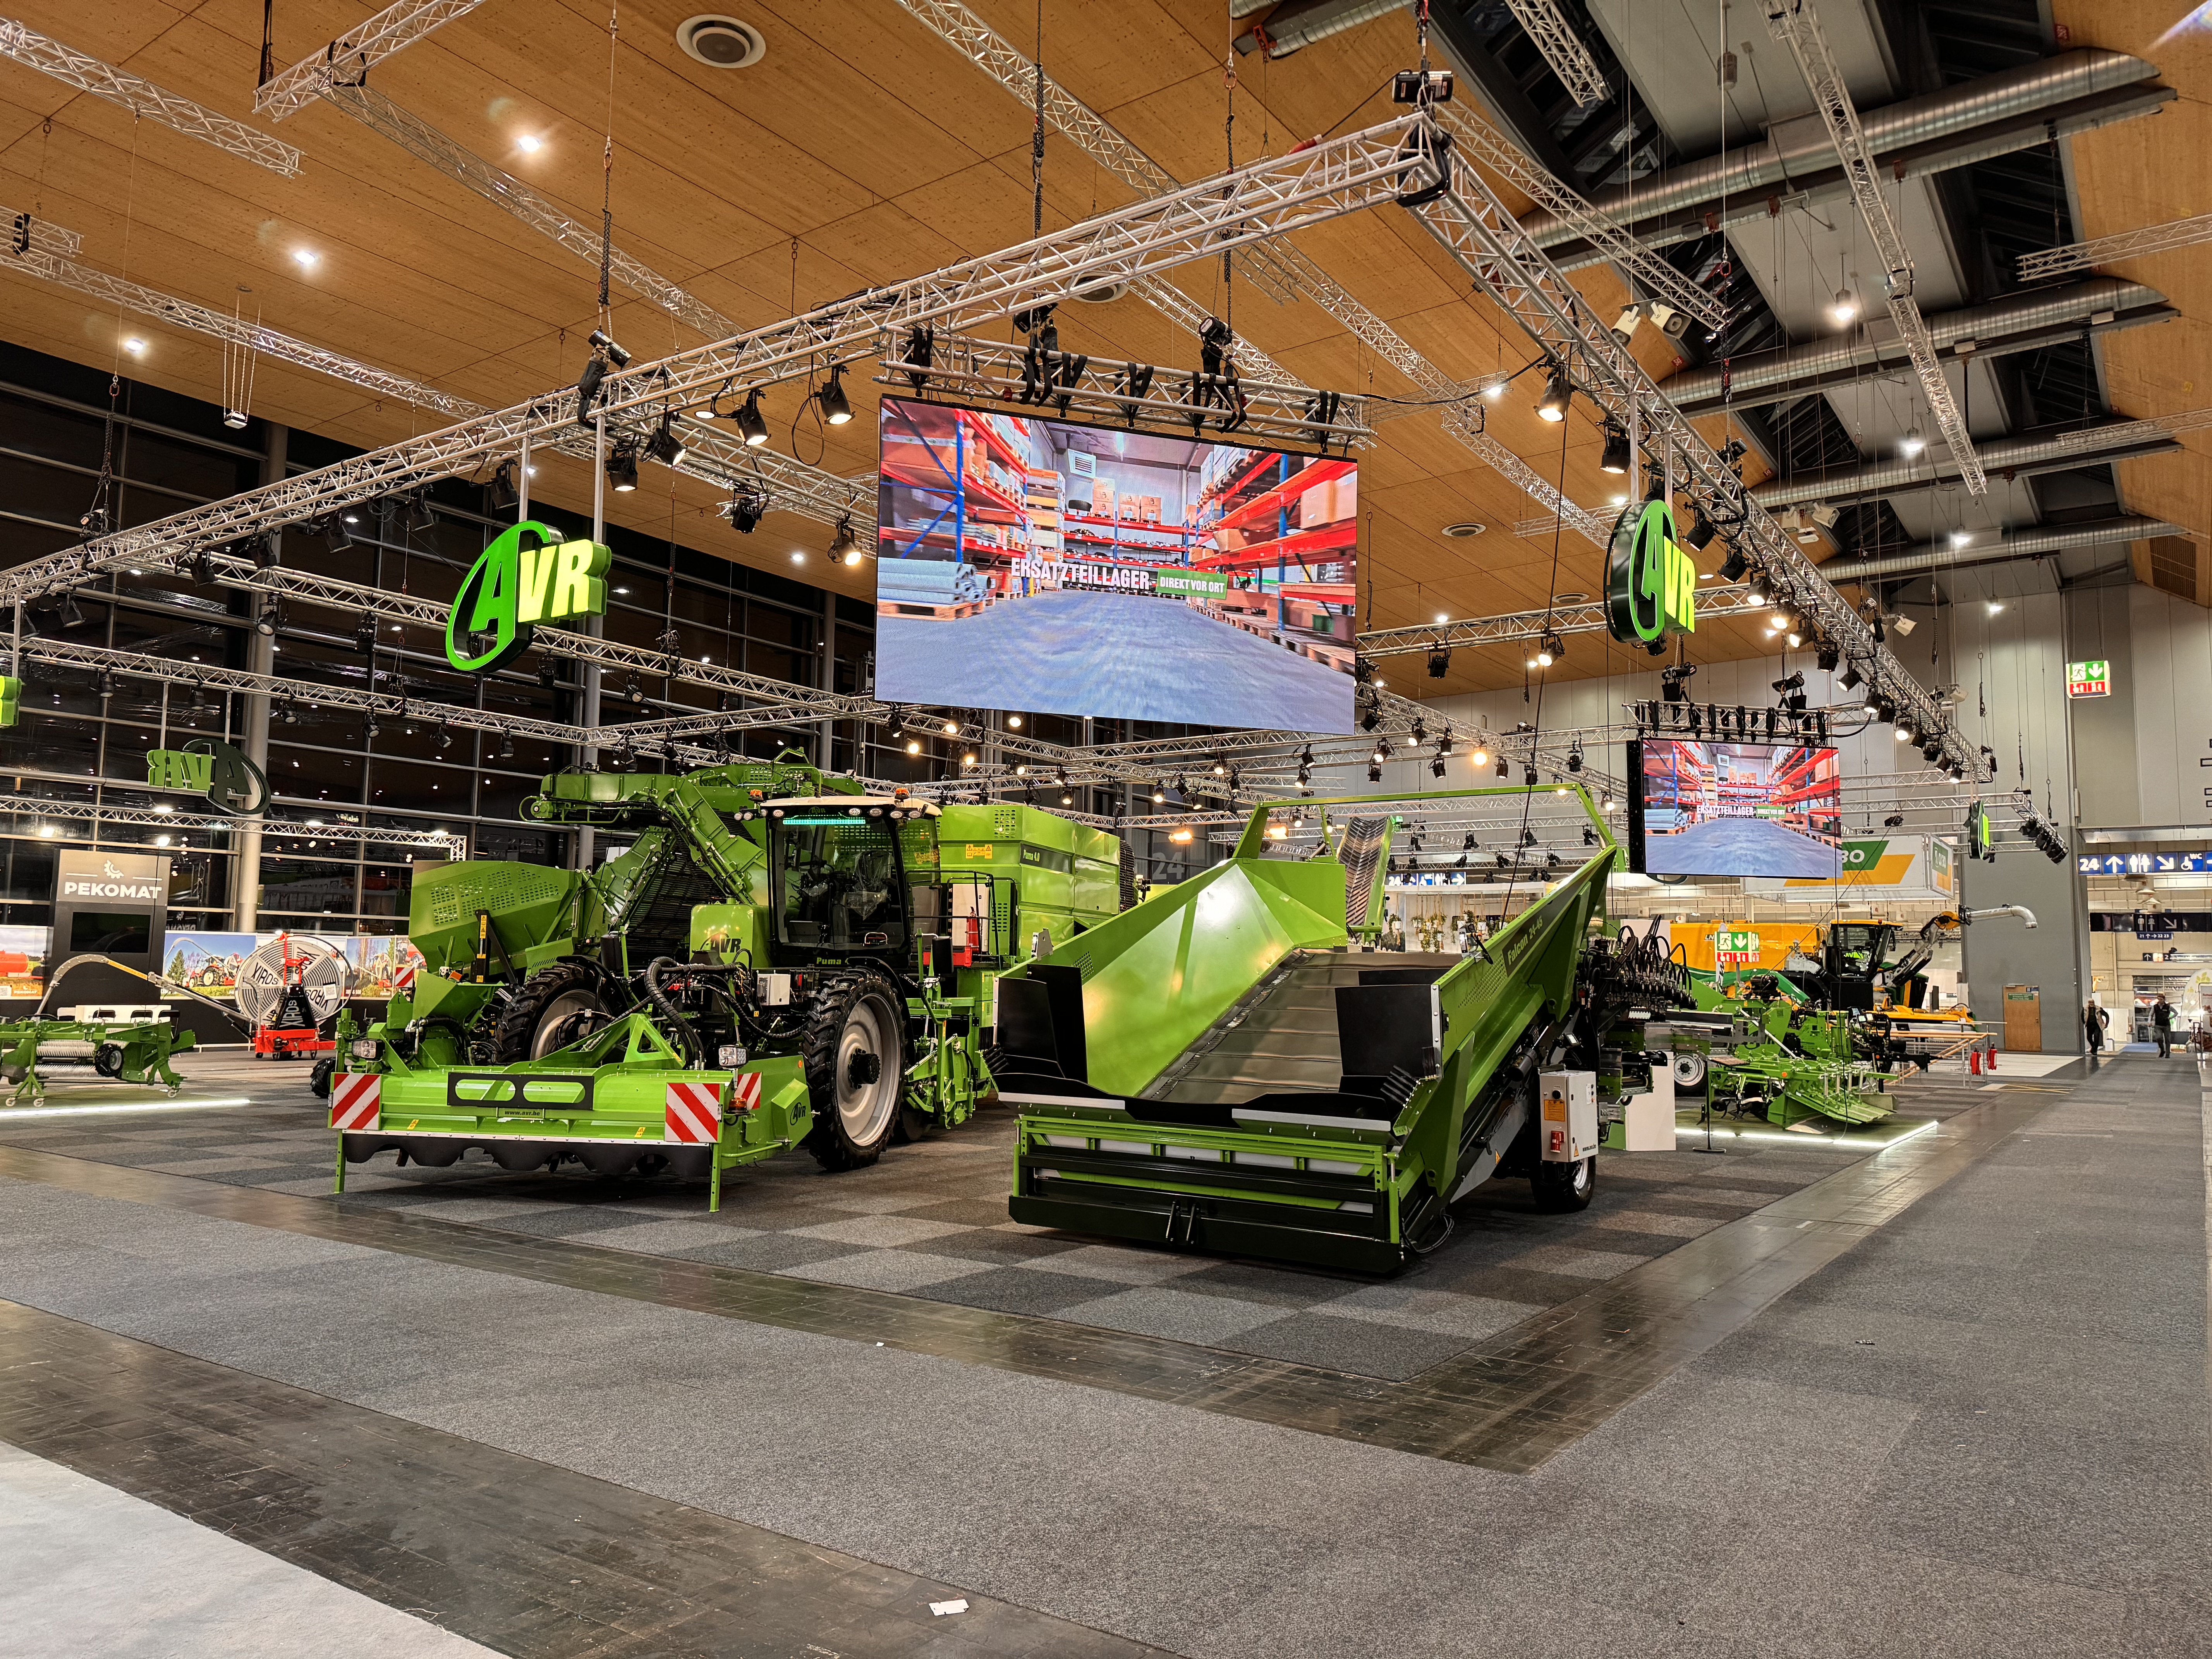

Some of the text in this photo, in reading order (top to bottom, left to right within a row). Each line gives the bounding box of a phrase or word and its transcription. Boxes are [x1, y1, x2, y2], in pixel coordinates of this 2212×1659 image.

[1011, 557, 1224, 593] ERSATZTEILLAGER DIREKT VOR ORT
[1628, 500, 1695, 641] AVR
[445, 520, 594, 671] AVR
[1023, 849, 1033, 860] Puma
[1152, 852, 1185, 880] 24
[2080, 858, 2099, 871] 24
[64, 881, 162, 899] PEKOMAT
[1389, 876, 1401, 886] 24
[699, 933, 741, 953] AVR
[1508, 915, 1543, 965] Falcon 24-45
[251, 962, 278, 985] XIROS
[279, 1000, 306, 1028] XIROS
[790, 1102, 806, 1126] AVR
